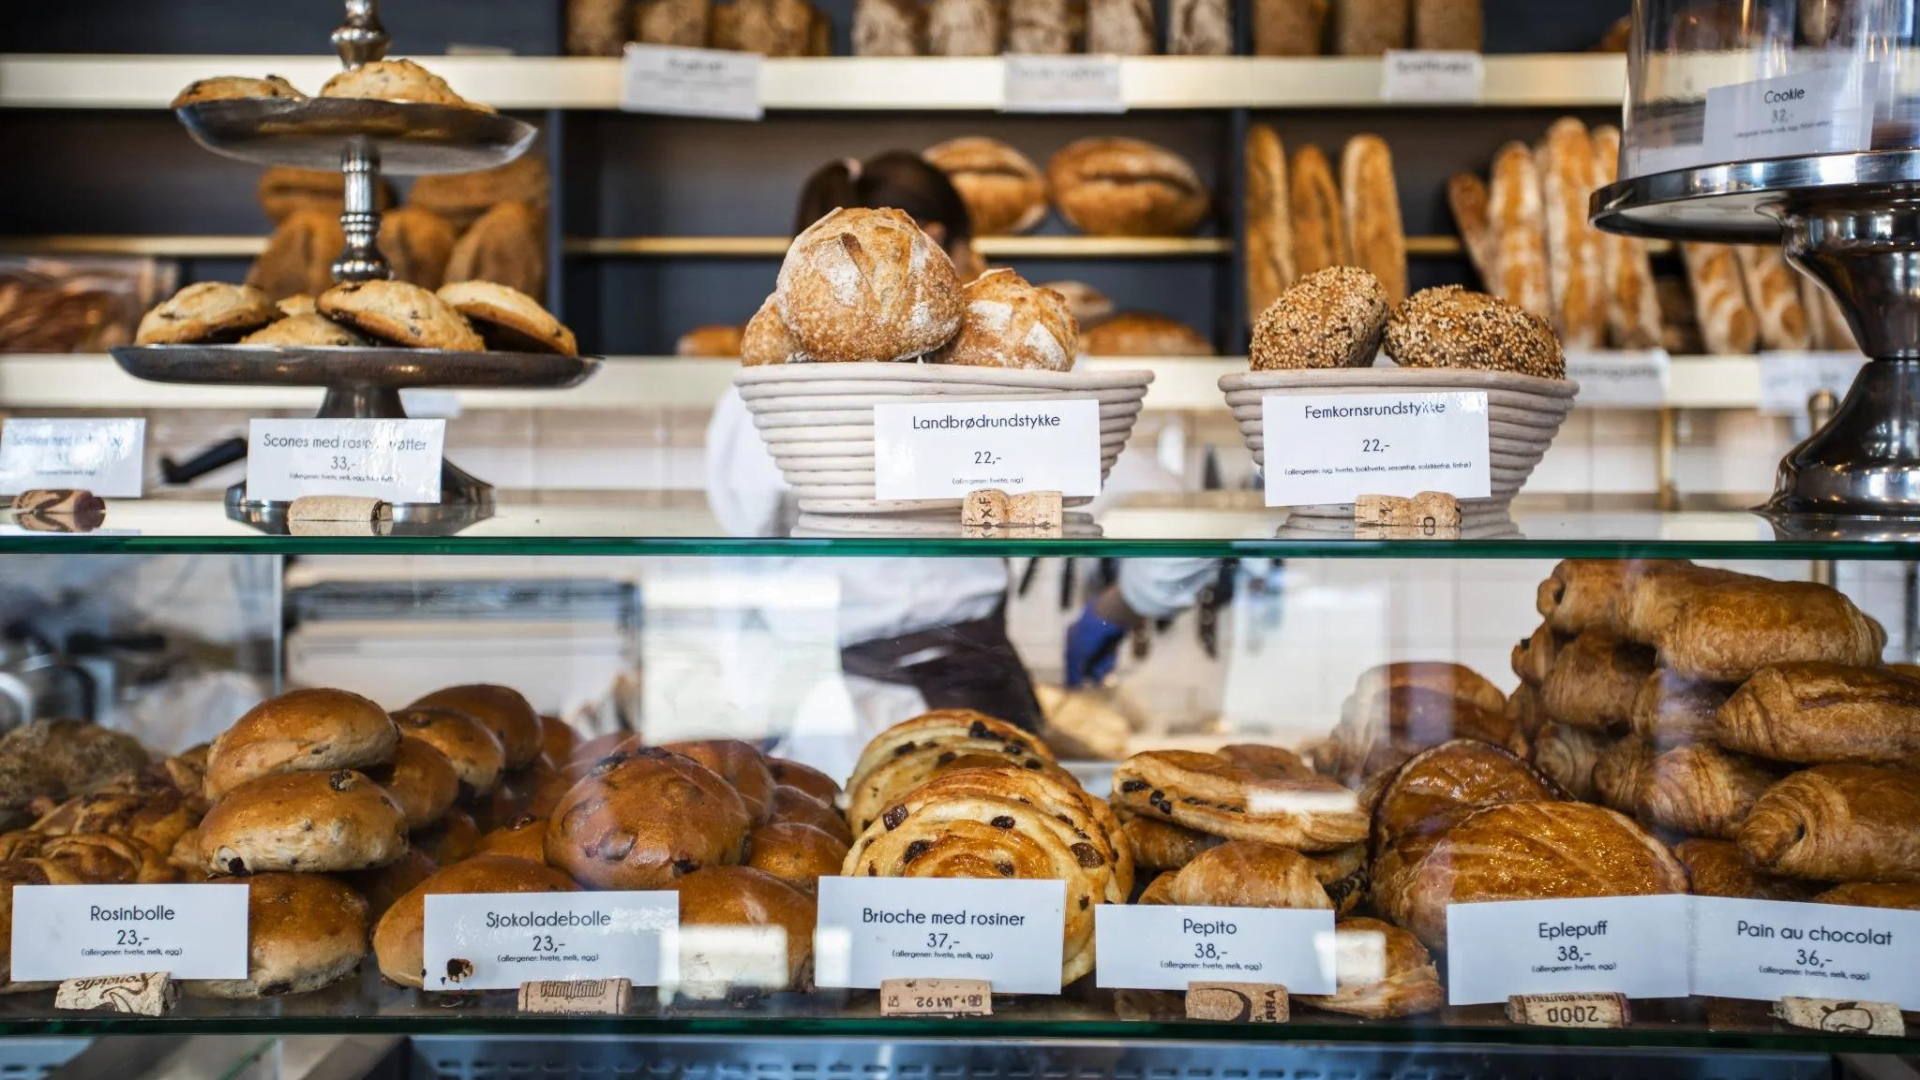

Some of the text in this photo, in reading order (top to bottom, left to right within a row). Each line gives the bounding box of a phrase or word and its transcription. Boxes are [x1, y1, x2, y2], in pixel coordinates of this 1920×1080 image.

[1764, 88, 1805, 104] Cookie
[1305, 401, 1446, 419] Femkornsrundstykke
[913, 413, 1061, 430] Landbrødrundstykke
[263, 433, 309, 448] Scones
[312, 435, 340, 449] med
[1362, 439, 1390, 453] 22,-
[330, 456, 357, 471] 33,-
[974, 451, 1002, 465] 22,-
[90, 905, 175, 921] Rosinbolle
[486, 910, 611, 928] Sjokoladebolle
[862, 908, 1025, 927] Brioche med rosiner
[1183, 918, 1237, 937] Pepito
[1539, 920, 1608, 940] Eplepuff
[1737, 920, 1892, 946] Pain au chocolat
[116, 929, 150, 947] 23,-
[532, 935, 566, 953] 23,-
[926, 933, 960, 950] 37,-
[164, 948, 183, 957] egg)
[1194, 943, 1228, 960] 38,-
[1557, 945, 1591, 962] 38,-
[1796, 949, 1833, 968] 36,-
[1264, 990, 1277, 1023] RRA
[1547, 1006, 1599, 1023] 2000
